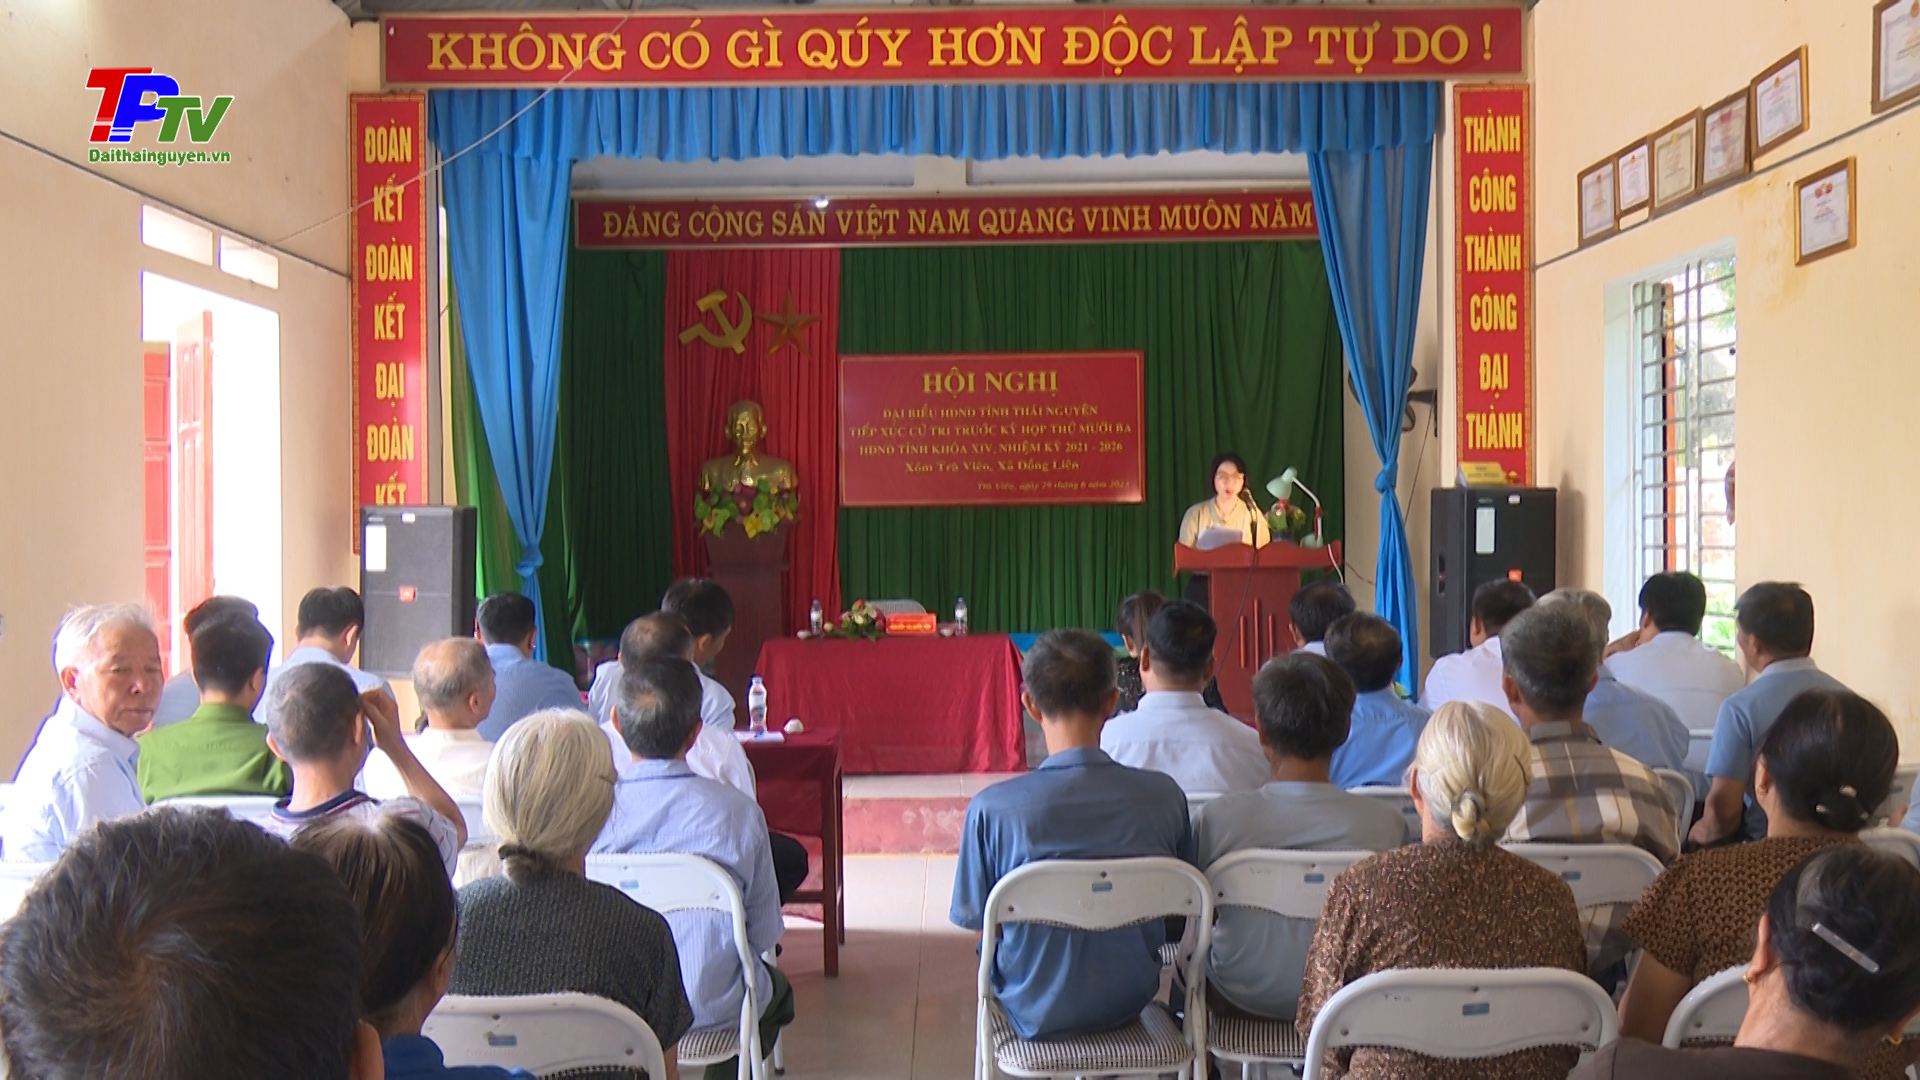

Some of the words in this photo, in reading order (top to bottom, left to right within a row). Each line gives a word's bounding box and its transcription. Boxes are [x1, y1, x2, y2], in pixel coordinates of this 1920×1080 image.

[427, 21, 627, 71] KHÔNG
[639, 18, 710, 70] CÓ
[727, 17, 783, 68] GÌ
[797, 17, 911, 68] QÚY
[928, 21, 1046, 67] HƠN
[1062, 14, 1173, 75] ĐỘC
[1188, 14, 1292, 74] LẬP
[1308, 20, 1380, 74] TỰ
[1393, 26, 1469, 65] DO
[1482, 23, 1493, 62] !
[364, 118, 412, 164] ĐOÀN
[1464, 108, 1521, 153] THÀNH
[373, 174, 405, 222] KẾT
[1469, 167, 1517, 213] CÔNG
[603, 205, 681, 237] ĐẢNG
[688, 204, 764, 242] CỘNG
[772, 204, 826, 236] SẢN
[835, 203, 900, 241] VIỆT
[907, 207, 970, 235] NAM
[978, 207, 1075, 236] QUANG
[1081, 204, 1151, 232] VINH
[1158, 198, 1241, 231] MUÔN
[1250, 198, 1313, 229] NĂM
[365, 236, 413, 282] ĐOÀN
[1464, 226, 1521, 272] THÀNH
[374, 291, 406, 340] KẾT
[1470, 286, 1517, 332] CÔNG
[375, 361, 405, 408] ĐẠI
[923, 365, 976, 399] HỘI
[984, 369, 1058, 398] NGHỊ
[1479, 353, 1509, 399] ĐẠI
[366, 416, 414, 462] ĐOÀN
[1066, 441, 1088, 453] 2021
[1099, 441, 1123, 453] 2026
[1465, 404, 1523, 450] THÀNH
